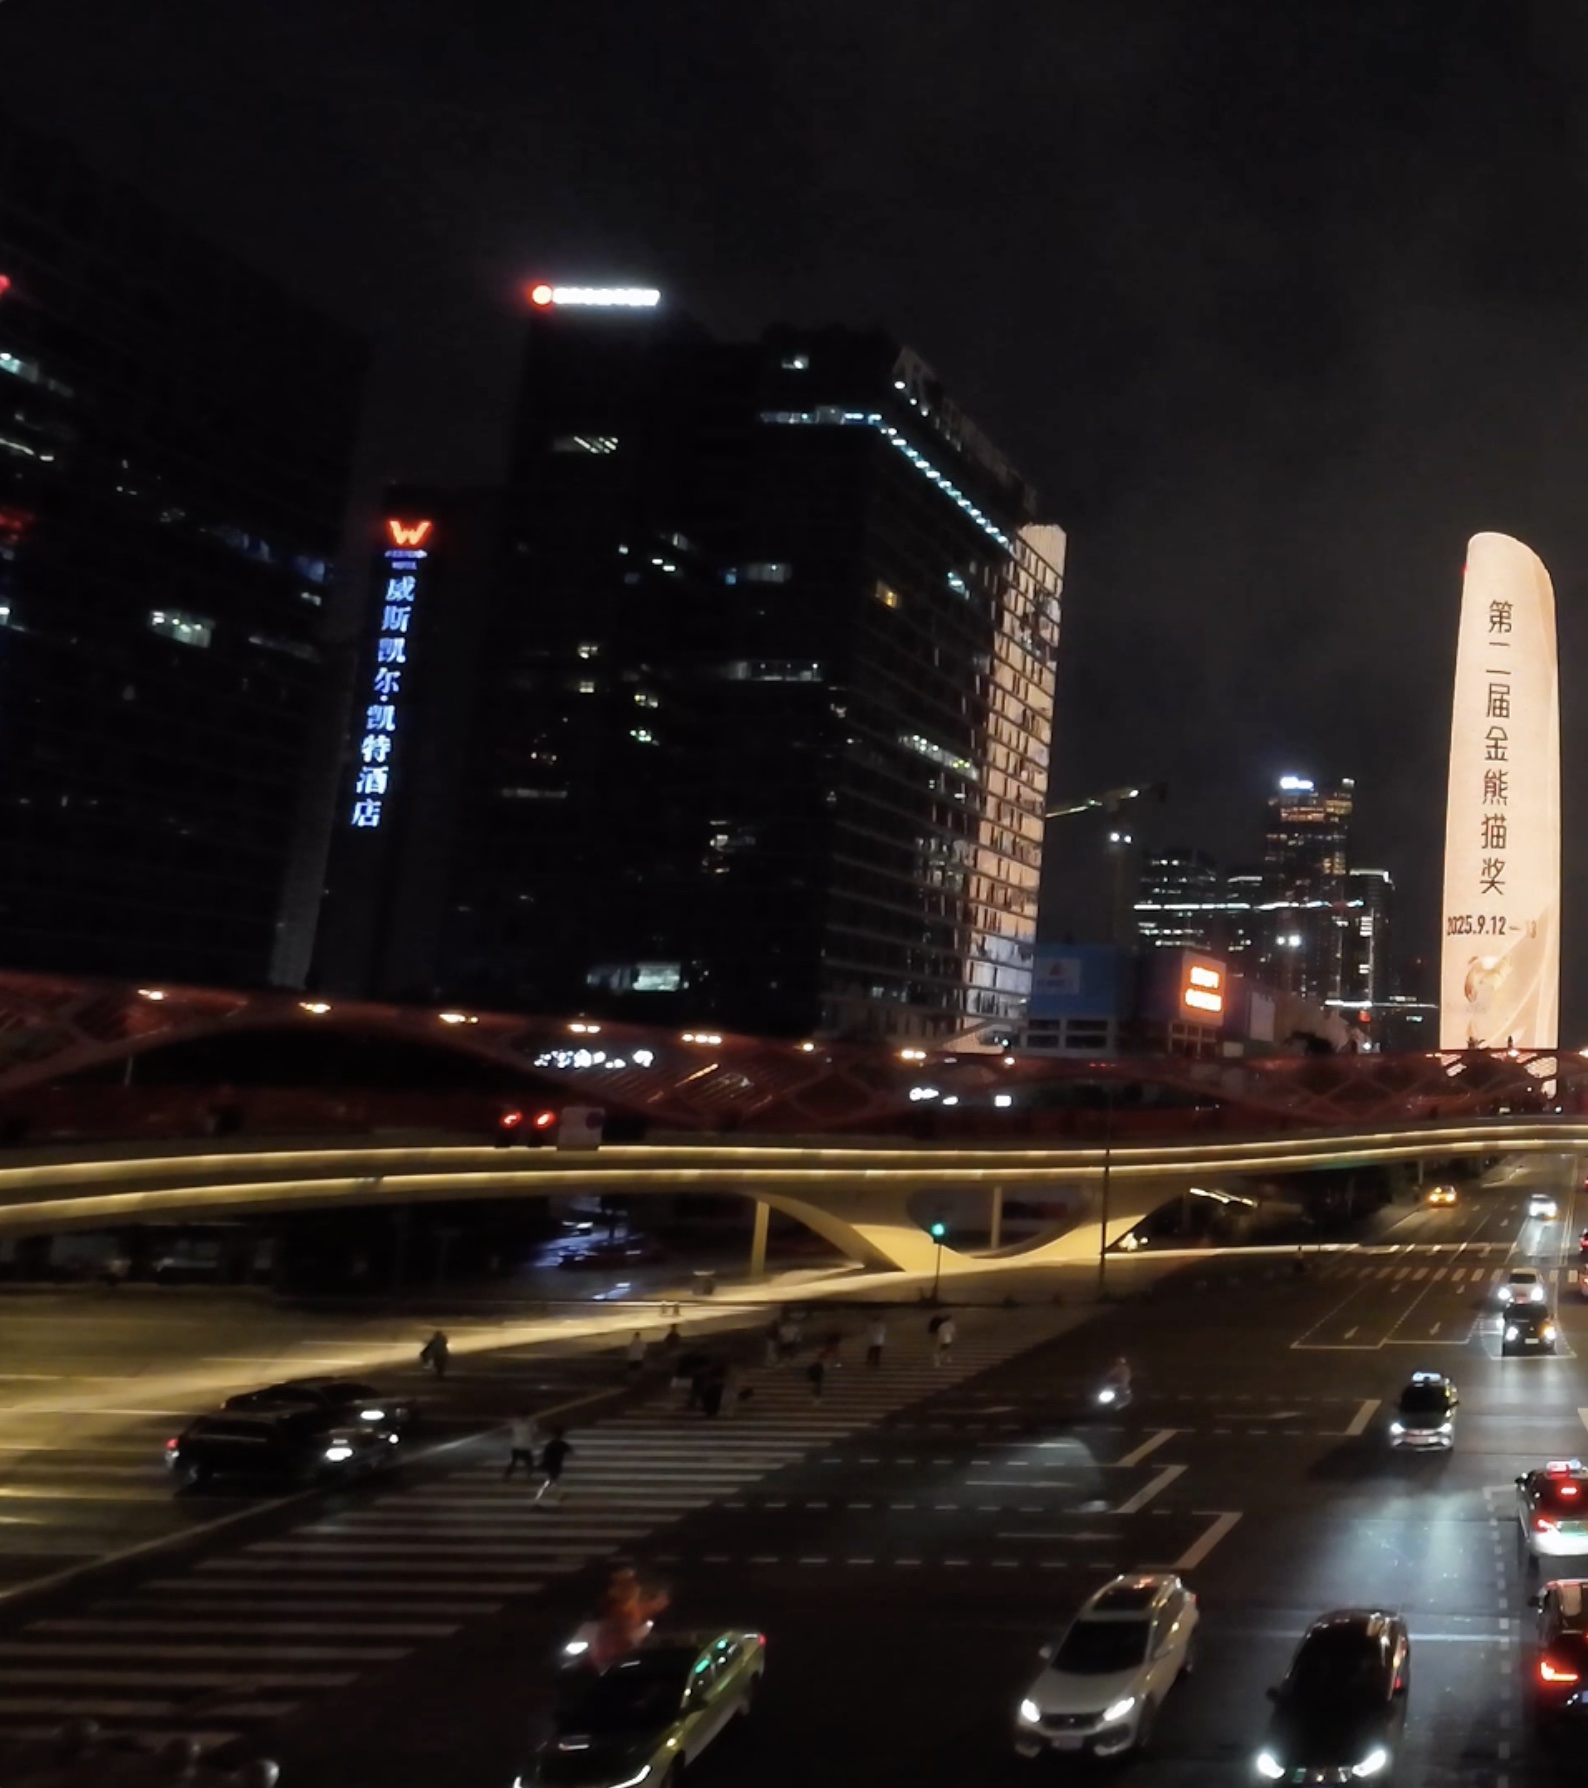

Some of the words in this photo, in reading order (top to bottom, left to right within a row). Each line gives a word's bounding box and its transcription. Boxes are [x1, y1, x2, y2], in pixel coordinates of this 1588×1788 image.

[1479, 599, 1513, 895] 第二届金熊猫奖
